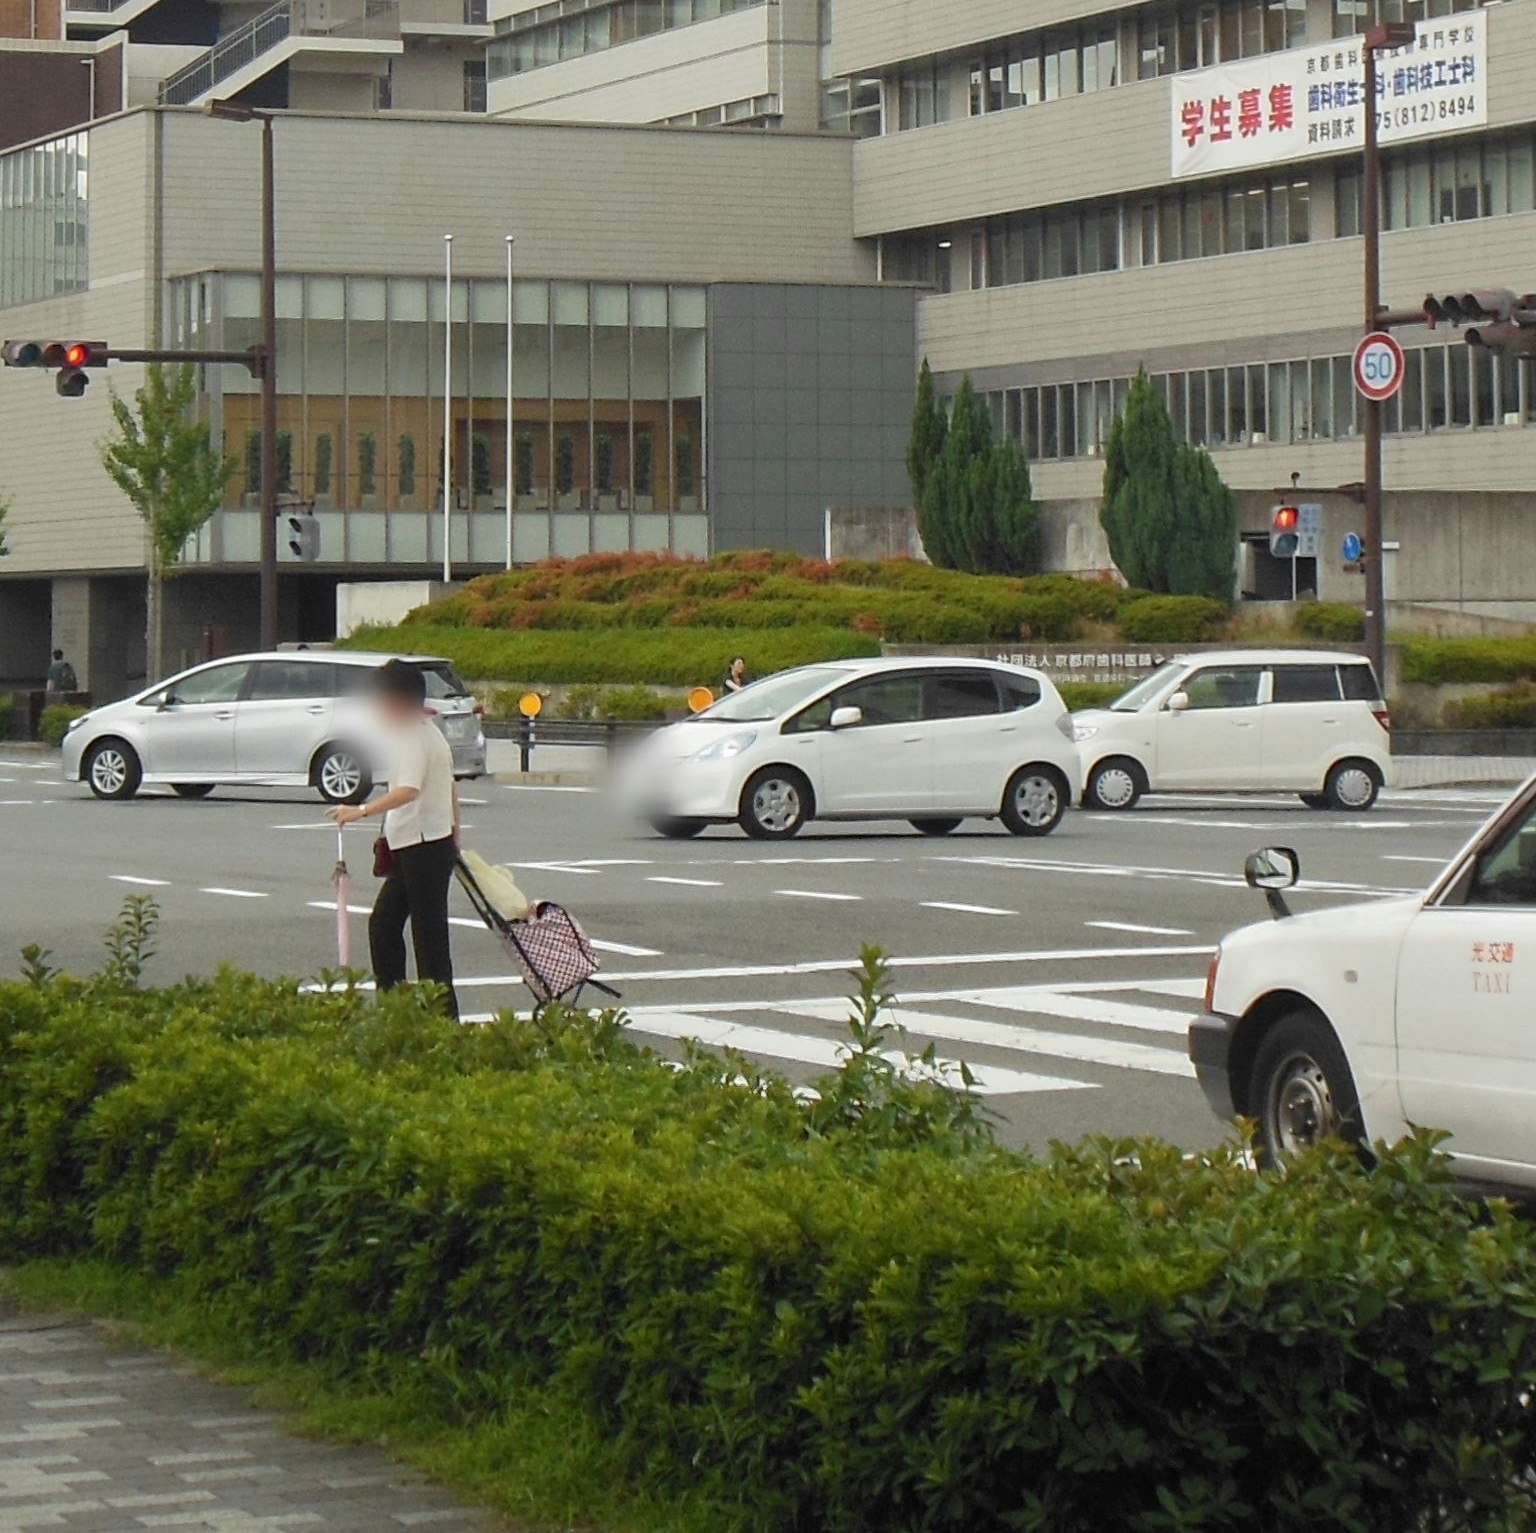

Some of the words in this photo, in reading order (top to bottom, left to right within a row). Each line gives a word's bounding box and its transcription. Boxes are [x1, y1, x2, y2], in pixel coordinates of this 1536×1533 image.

[1181, 82, 1294, 149] 学生募集
[1308, 117, 1356, 145] 資料請求
[1375, 95, 1475, 133] 75(812)8494
[1364, 351, 1392, 381] 50
[996, 653, 1052, 668] 社団法人
[1471, 941, 1515, 964] 光交通
[1471, 971, 1512, 995] TAXI
